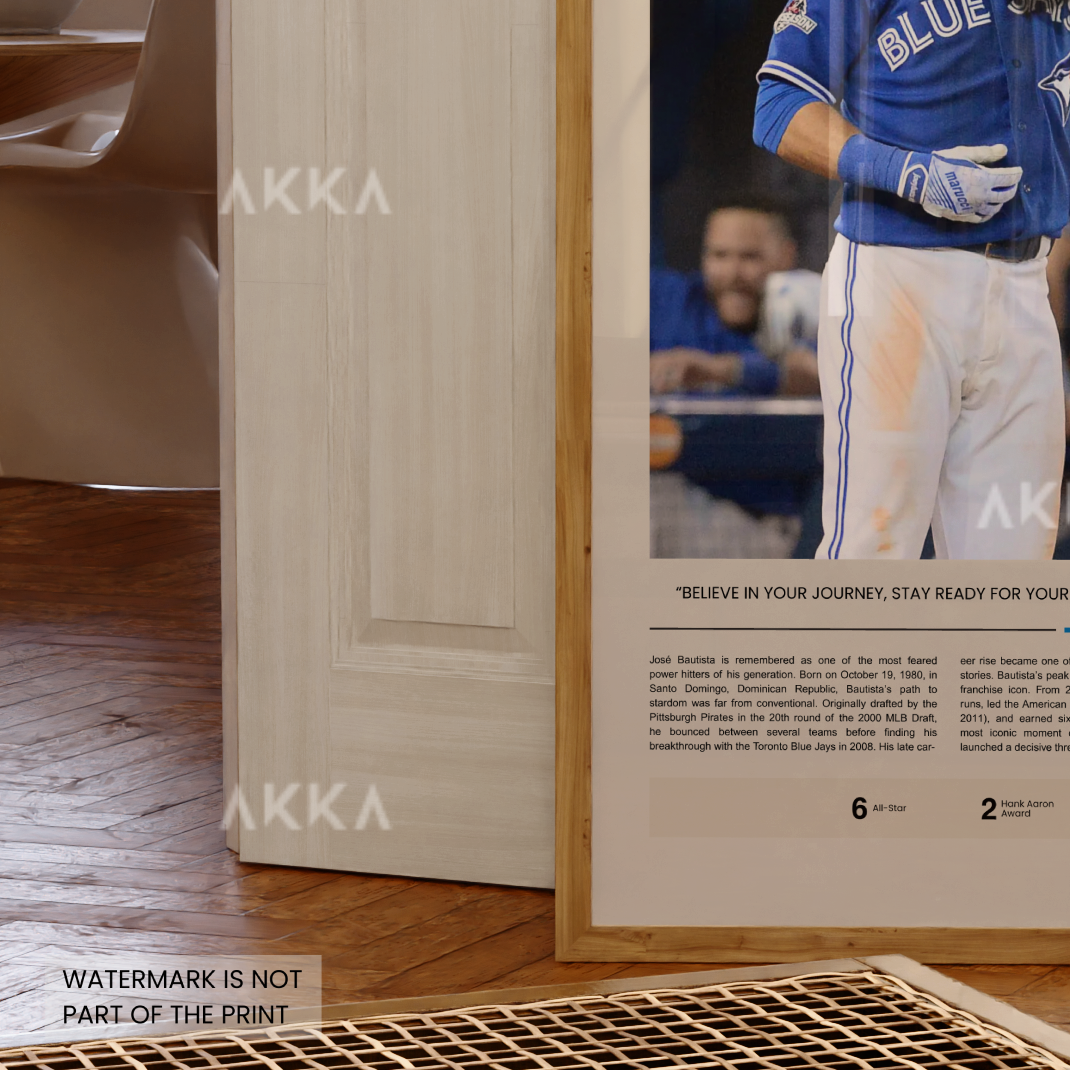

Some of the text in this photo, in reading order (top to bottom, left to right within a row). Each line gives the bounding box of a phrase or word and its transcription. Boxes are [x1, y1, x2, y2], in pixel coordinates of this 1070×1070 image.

[944, 171, 974, 211] marucci
[676, 586, 739, 599] “BELIEVE
[744, 587, 758, 599] IN
[764, 586, 807, 599] YOUR
[812, 587, 887, 602] JOURNEY,
[892, 587, 930, 600] STAY
[936, 587, 986, 600] READY
[991, 587, 1020, 600] FOR
[1026, 587, 1068, 600] YOUR
[649, 655, 671, 664] José
[678, 655, 715, 664] Bautista
[722, 655, 729, 664] is
[736, 656, 794, 664] remembered
[842, 656, 851, 664] of
[858, 656, 872, 664] the
[907, 656, 937, 665] feared
[650, 684, 937, 695] Santo Domingo, Dominican Republic, Bautista's path to
[960, 685, 1003, 694] franchise
[1009, 685, 1030, 694] icon.
[1036, 685, 1060, 694] From
[960, 743, 1003, 751] launched
[1015, 743, 1052, 752] decisive
[852, 797, 907, 820] 6 All-Star
[981, 797, 997, 820] 2
[1001, 799, 1055, 808] Hank Aaron
[1001, 809, 1031, 818] Award
